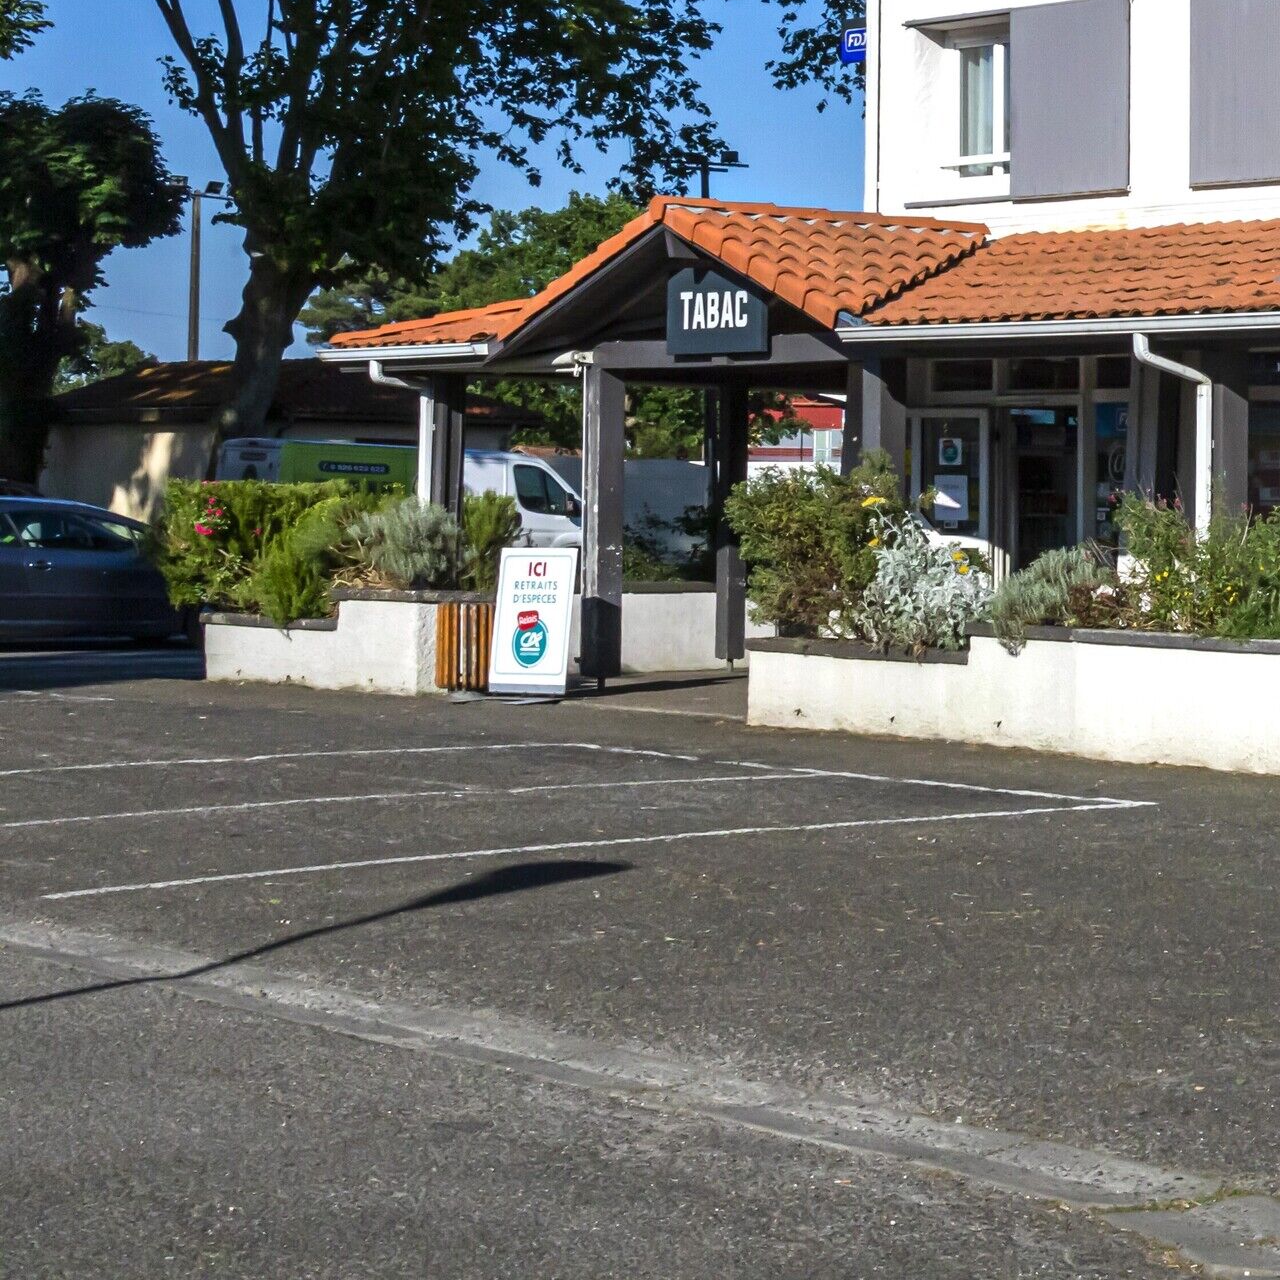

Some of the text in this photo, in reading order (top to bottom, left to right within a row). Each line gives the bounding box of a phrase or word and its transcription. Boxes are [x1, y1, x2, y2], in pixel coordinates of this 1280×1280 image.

[680, 290, 748, 330] TABAC
[528, 561, 547, 577] ICI
[514, 580, 558, 591] RETRAITS
